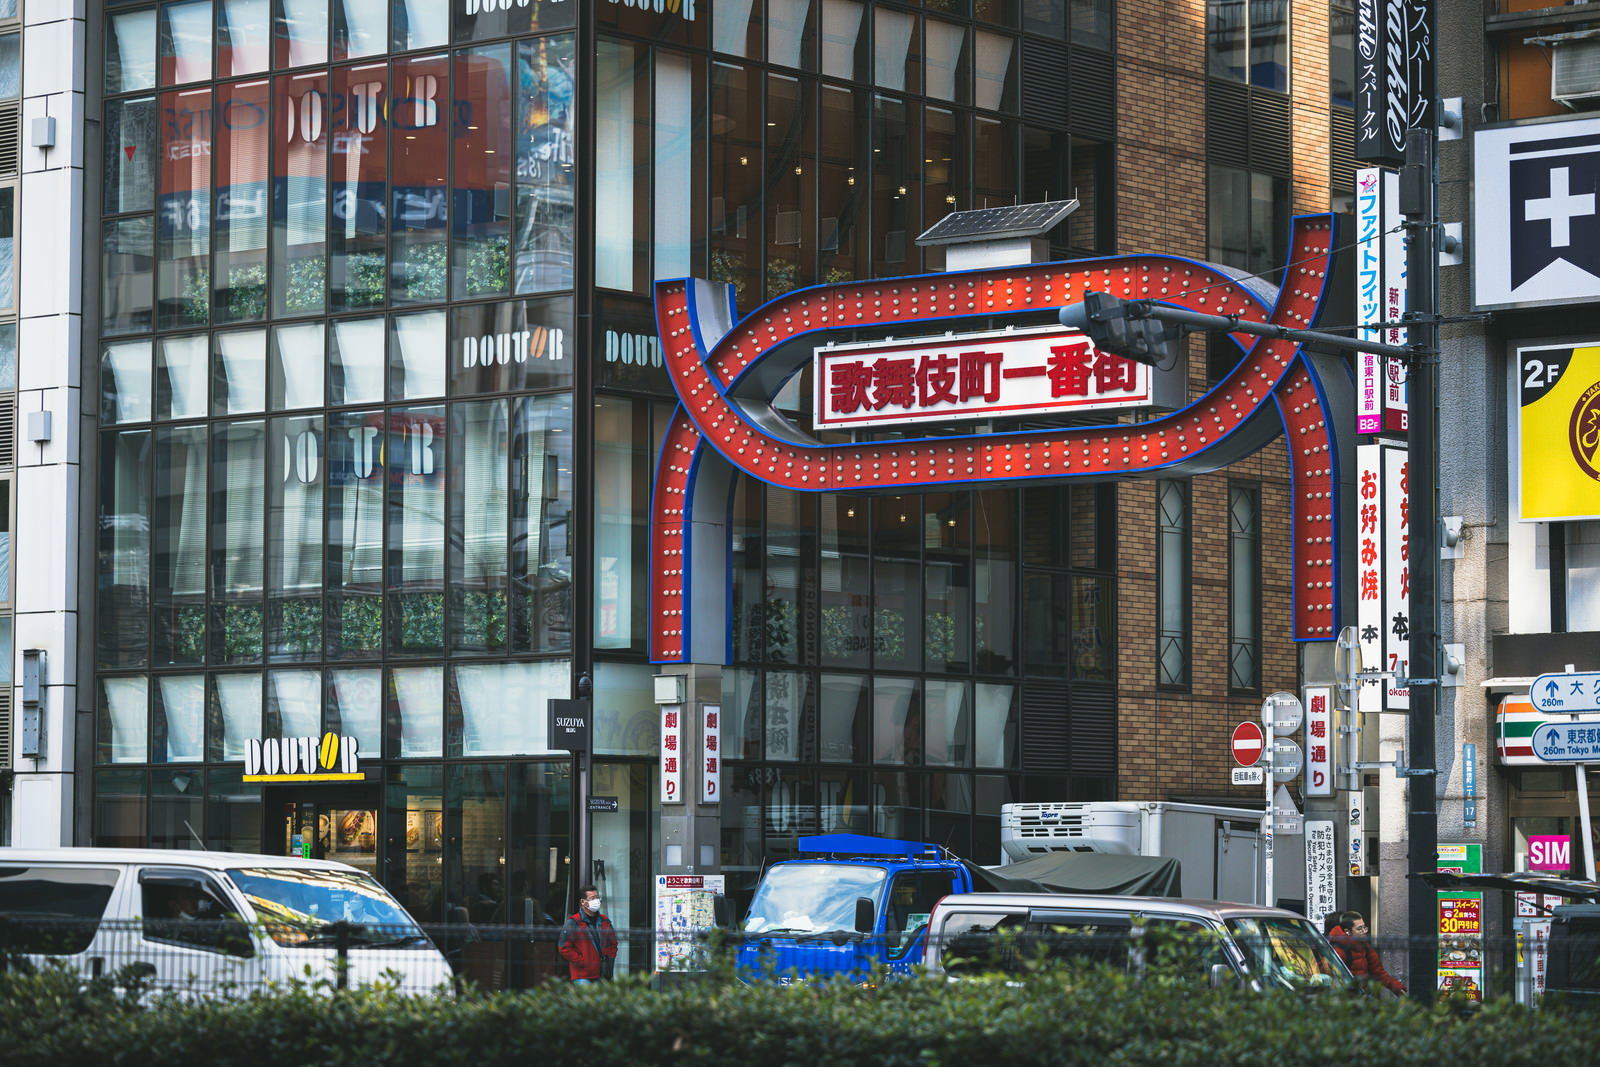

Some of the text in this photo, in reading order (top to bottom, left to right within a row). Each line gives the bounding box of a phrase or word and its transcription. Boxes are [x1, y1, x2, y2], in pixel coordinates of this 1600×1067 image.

[1360, 64, 1379, 143] スパークル
[463, 326, 564, 369] DOUTOR
[829, 341, 1138, 413] 歌舞伎町一番街
[1524, 359, 1560, 389] 2F
[1360, 419, 1379, 431] B2F
[1542, 697, 1564, 707] 260m
[556, 717, 585, 728] SUZUYA
[1567, 728, 1600, 744] 東京都
[244, 731, 360, 775] DOUTOR
[664, 711, 678, 795] 劇場通り
[706, 712, 718, 795] 劇場通り
[1310, 695, 1326, 787] 劇場通り
[1543, 746, 1565, 755] 260m
[1567, 745, 1589, 756] Tokyo
[1465, 807, 1475, 816] 17
[1530, 841, 1570, 865] SIM
